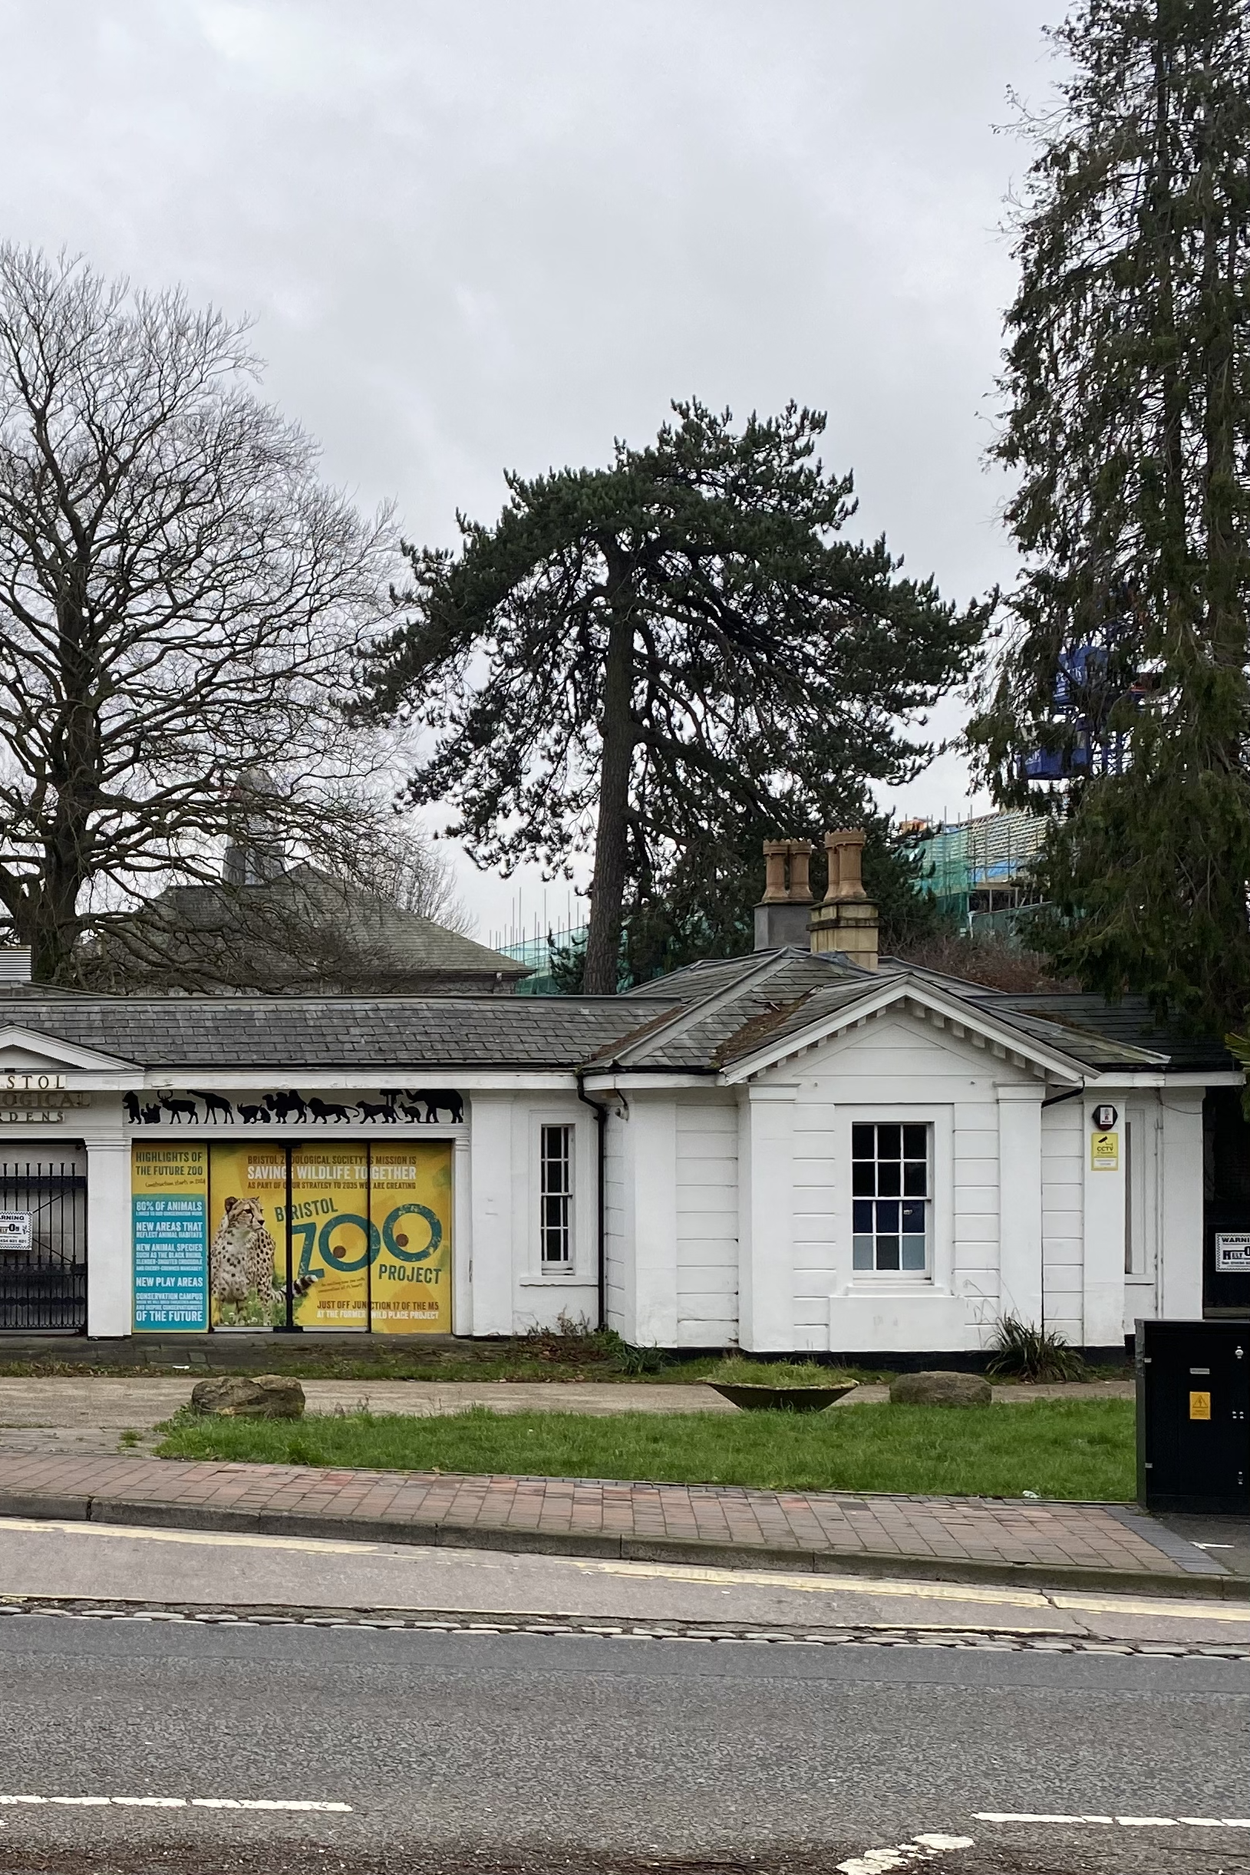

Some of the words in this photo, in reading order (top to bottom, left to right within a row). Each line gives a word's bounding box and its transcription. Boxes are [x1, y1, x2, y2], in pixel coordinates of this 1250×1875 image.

[136, 1152, 189, 1162] HIGHLIGHTS
[192, 1152, 202, 1162] OF
[248, 1156, 278, 1164] BRISTOL
[375, 1156, 407, 1164] MISSION
[409, 1156, 416, 1164] IS
[136, 1166, 151, 1175] THE
[154, 1166, 184, 1175] FUTURE
[187, 1166, 202, 1175] ZOO
[247, 1166, 293, 1179] SAVING
[297, 1166, 350, 1179] WILDLIFE
[354, 1166, 416, 1179] TOGETHER
[155, 1202, 165, 1211] OF
[167, 1202, 202, 1211] ANIMALS
[274, 1198, 338, 1222] BRISTOL
[136, 1222, 154, 1231] NEW
[156, 1222, 181, 1231] AREAS
[182, 1222, 202, 1231] THAT
[291, 1203, 442, 1279] ZOO
[378, 1264, 442, 1284] PROJECT
[136, 1277, 154, 1286] NEW
[156, 1277, 175, 1286] PLAY
[177, 1277, 203, 1286] AREAS
[352, 1301, 391, 1310] JUNCTION
[428, 1302, 439, 1310] M5
[136, 1311, 147, 1321] OF
[149, 1311, 167, 1321] THE
[169, 1311, 203, 1321] FUTURE
[370, 1311, 387, 1319] WILD
[388, 1311, 408, 1319] PLACE
